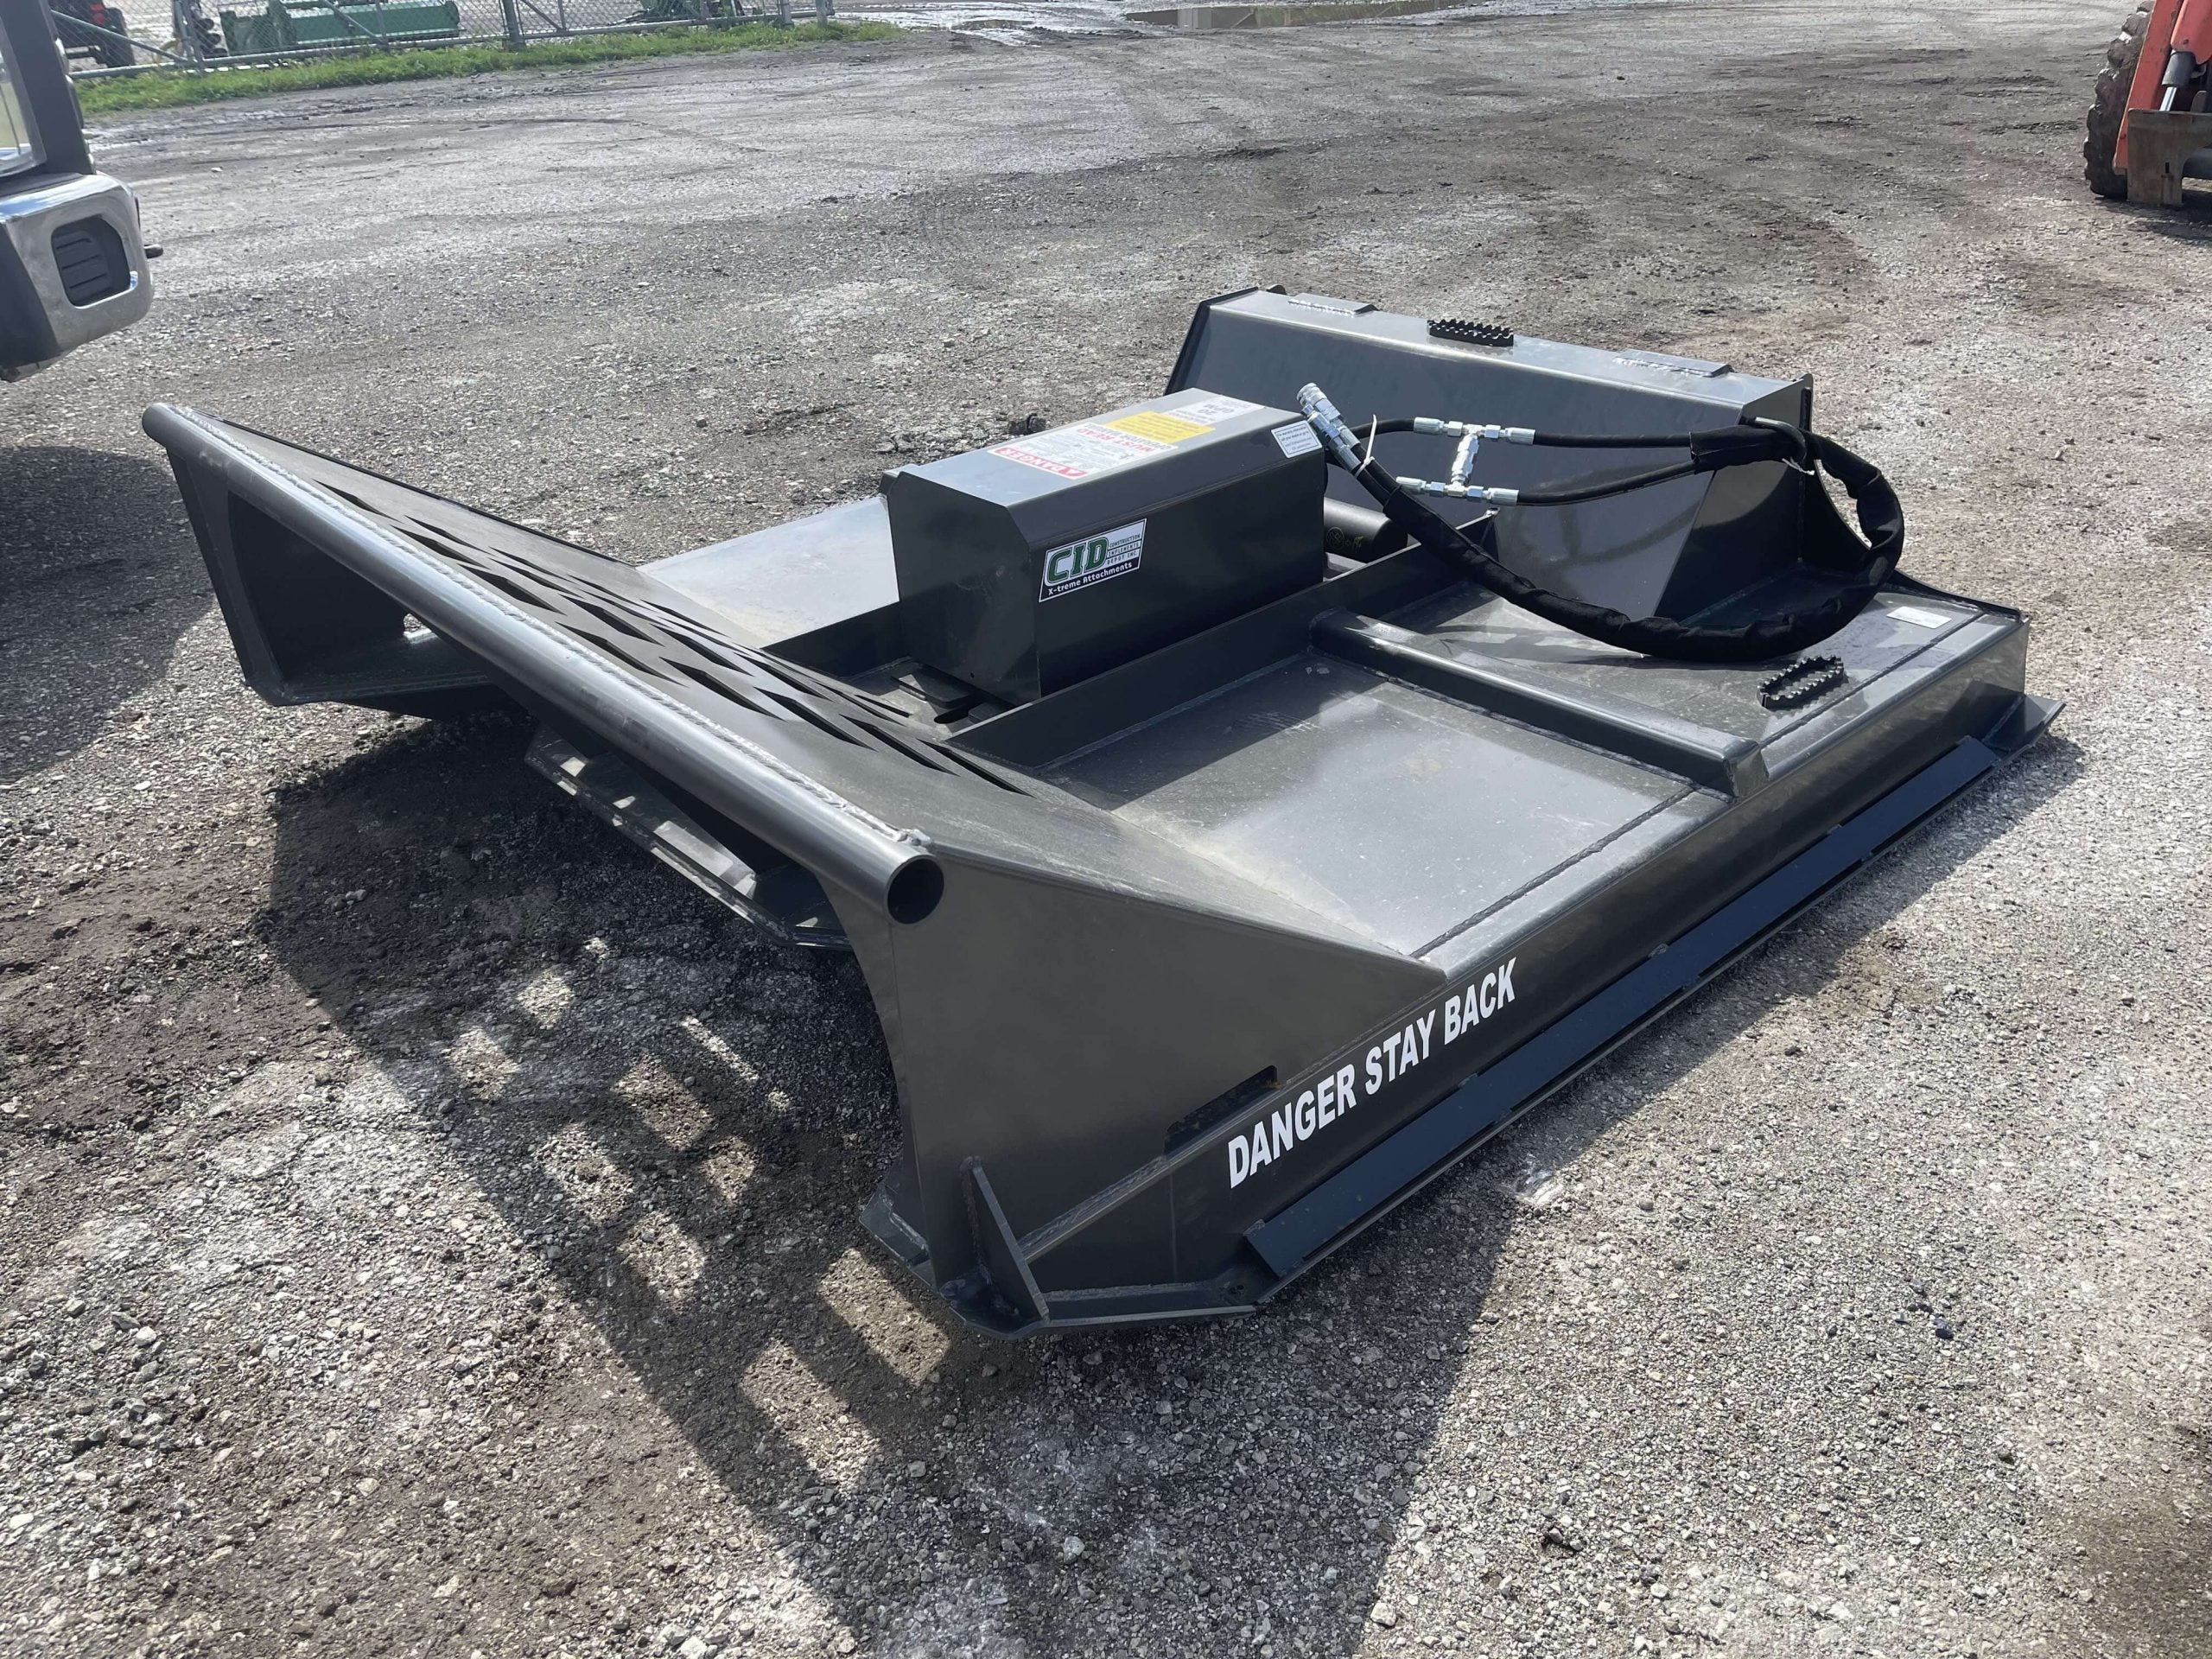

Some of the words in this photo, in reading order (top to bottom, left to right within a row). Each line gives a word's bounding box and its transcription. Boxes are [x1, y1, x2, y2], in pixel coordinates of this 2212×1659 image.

[1077, 429, 1115, 441] READ
[1113, 440, 1156, 452] MUST
[1000, 448, 1067, 471] DANGER
[1109, 533, 1141, 548] CONSTRUCTION
[1109, 543, 1139, 556] IMPLEMENTS
[1048, 537, 1109, 584] CID
[1107, 555, 1125, 565] DEPOT
[1048, 580, 1081, 595] X-treme
[1084, 562, 1132, 584] Attachments
[1228, 1064, 1357, 1188] DANGER
[1365, 1009, 1436, 1096] STAY
[1444, 957, 1516, 1046] BACK
